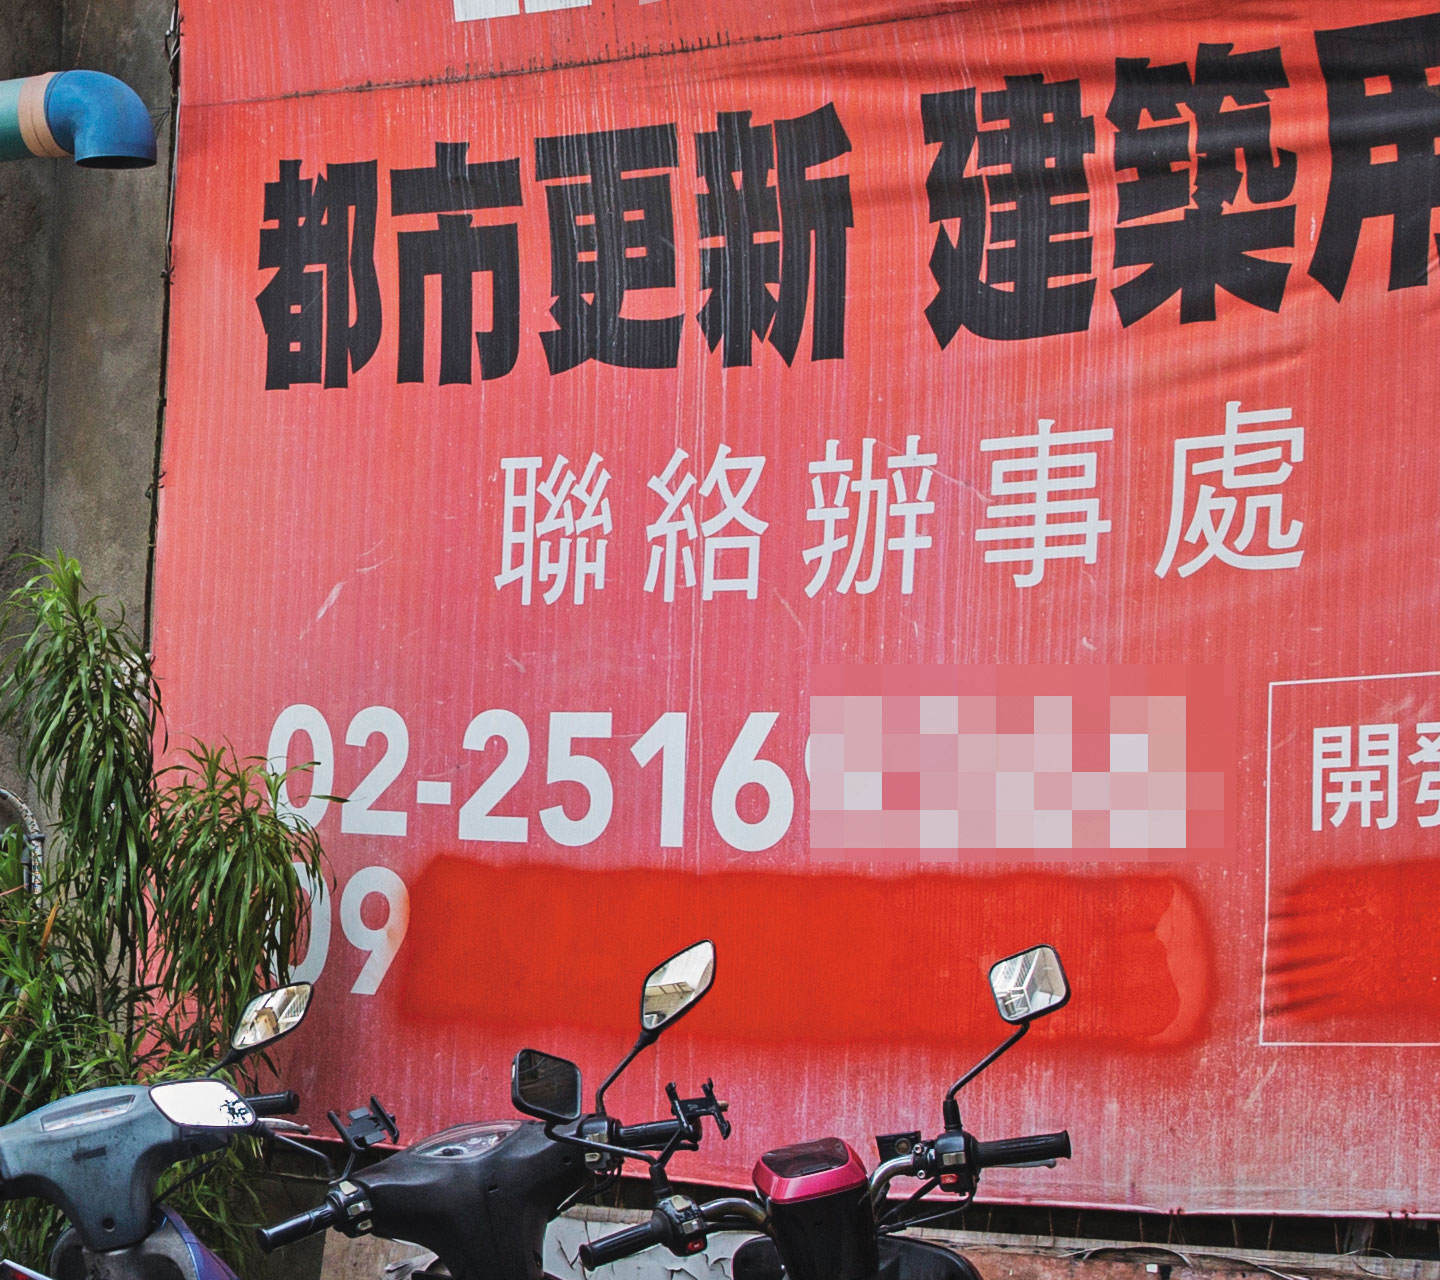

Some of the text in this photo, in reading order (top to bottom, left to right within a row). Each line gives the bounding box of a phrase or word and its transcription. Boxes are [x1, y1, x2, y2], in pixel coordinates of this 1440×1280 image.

[255, 101, 853, 392] 都市更新
[493, 401, 1308, 607] 聯絡辦事處
[266, 703, 1185, 854] 02-2516
